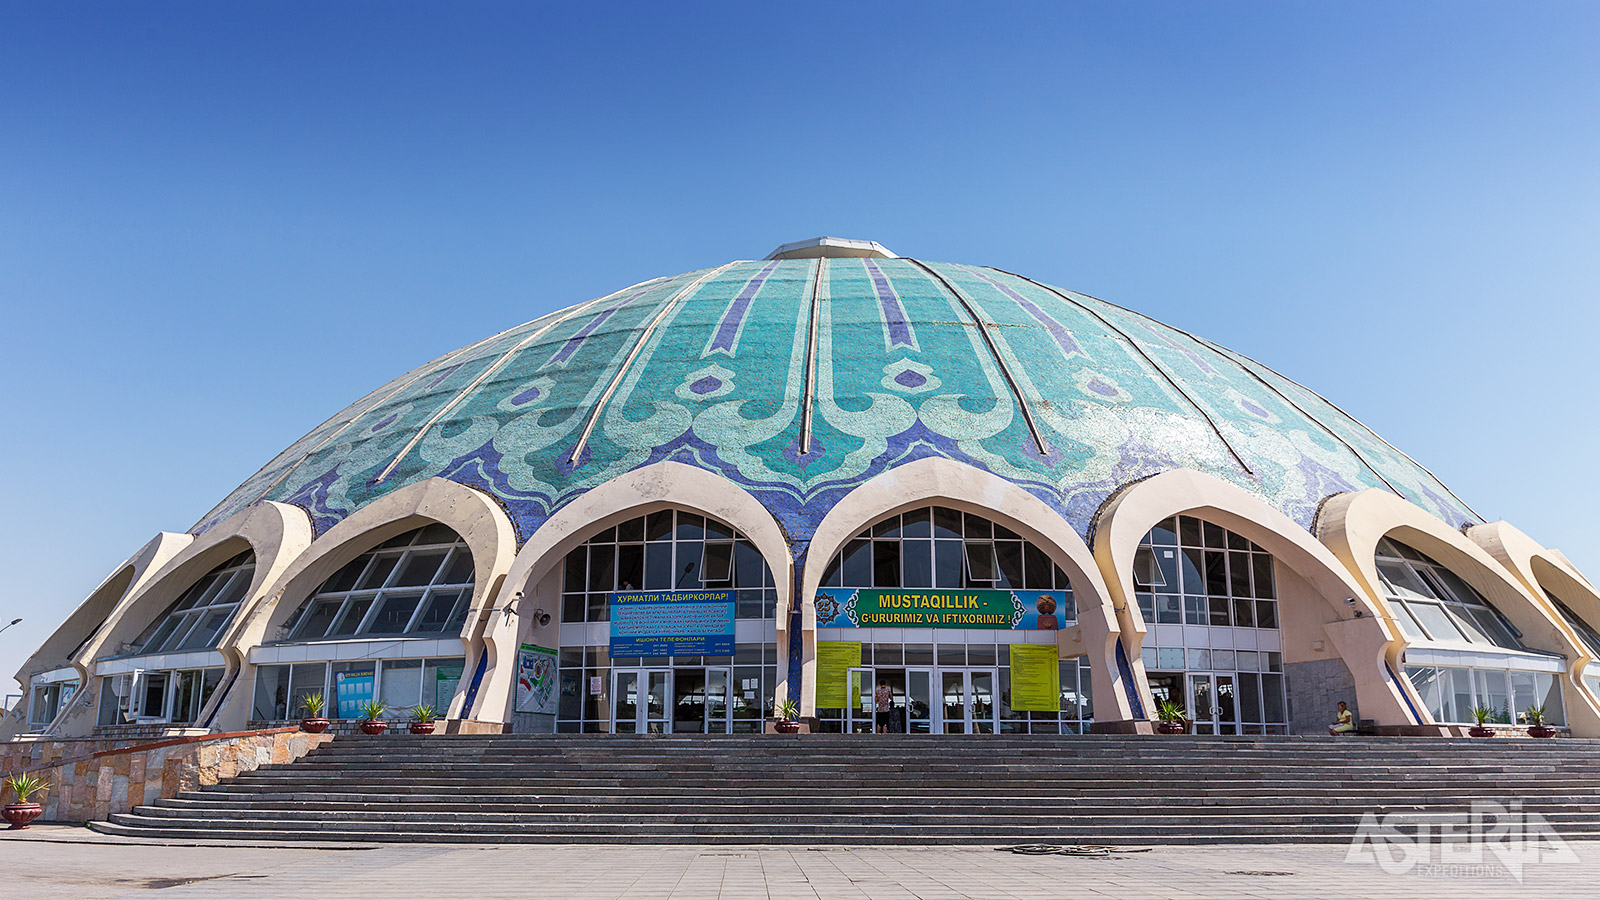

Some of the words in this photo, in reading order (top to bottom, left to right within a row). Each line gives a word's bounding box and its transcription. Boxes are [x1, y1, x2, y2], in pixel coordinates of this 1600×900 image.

[661, 592, 729, 602] ТАДБИРКОРЛАР!
[878, 594, 979, 610] MUSTAQILLIK
[817, 601, 831, 612] 25
[926, 613, 940, 623] VA
[942, 613, 1005, 624] IFTIXORIMIZ
